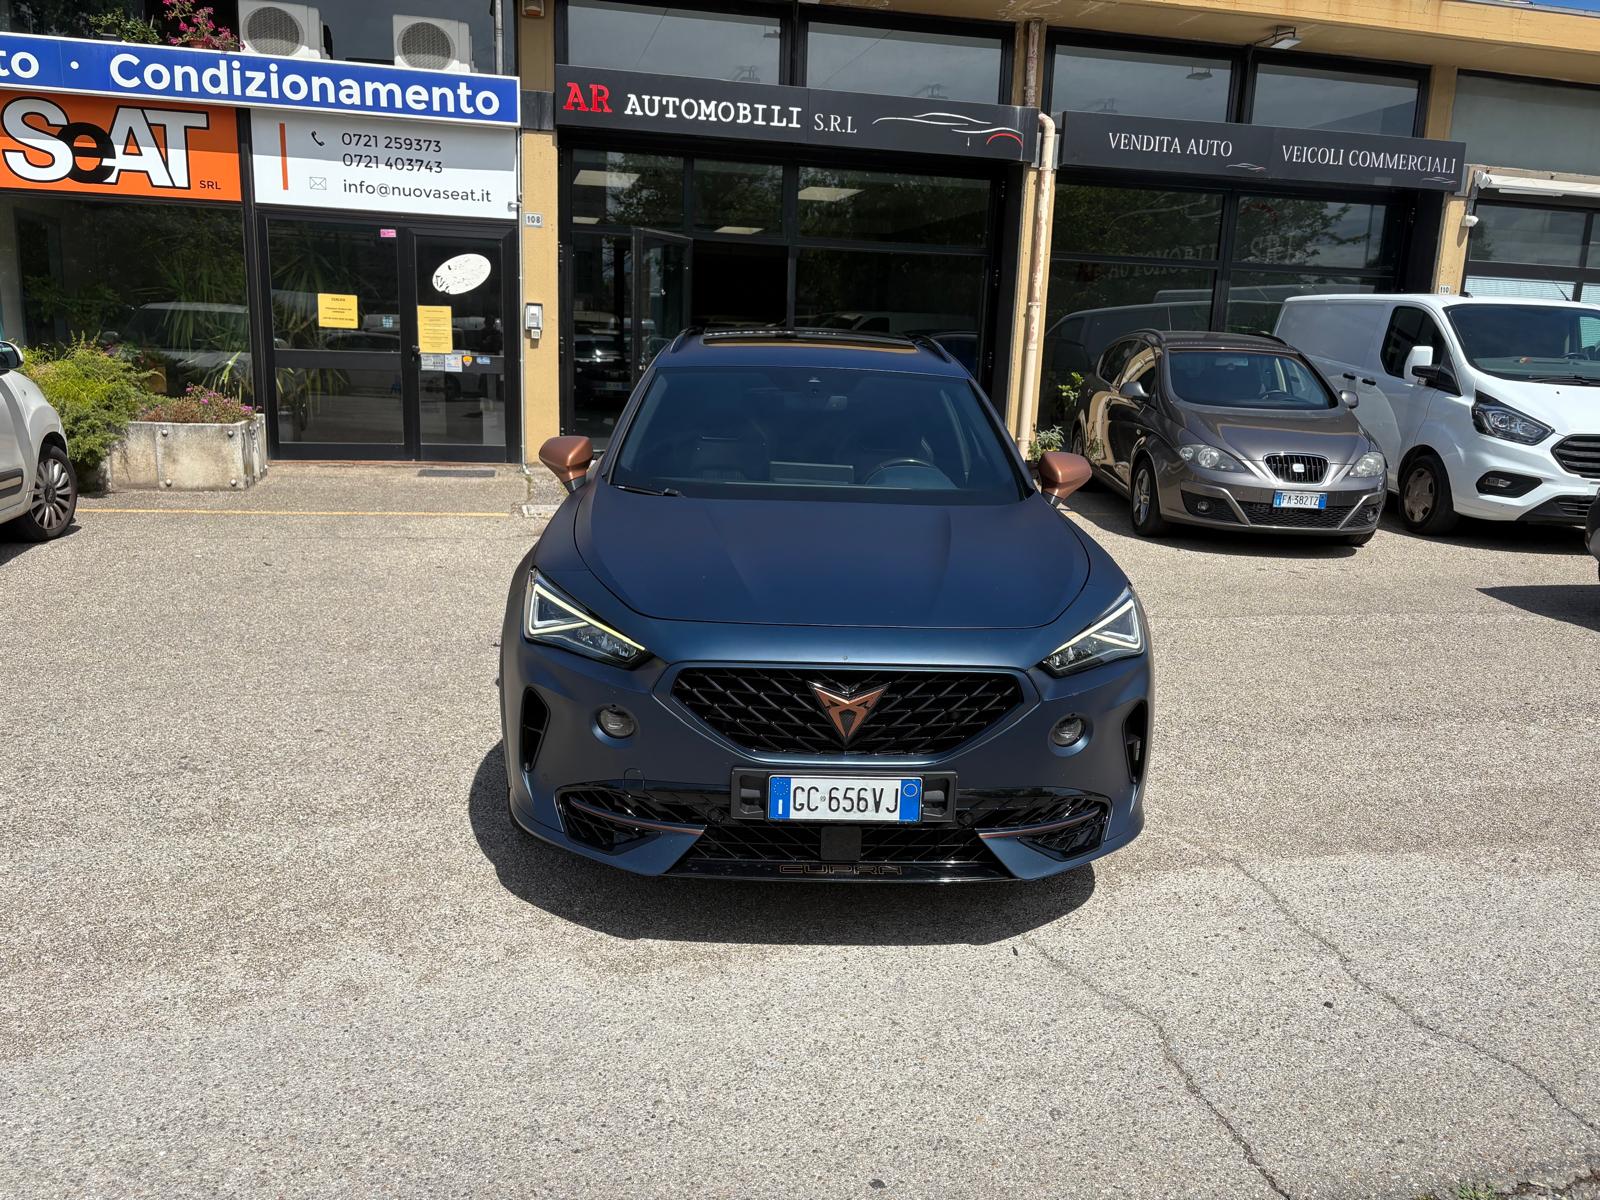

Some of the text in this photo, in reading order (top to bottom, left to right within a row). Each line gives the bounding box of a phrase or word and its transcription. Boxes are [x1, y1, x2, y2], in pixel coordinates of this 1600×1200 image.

[109, 53, 501, 116] Condizionamento
[562, 82, 857, 133] AR AUTOMOBILI S.R.L
[341, 132, 442, 153] 0721 259373
[1108, 132, 1233, 157] VENDITA AUTO
[342, 153, 443, 173] 0721 403743
[1282, 144, 1456, 174] VEICOLI COMMERCIALI
[199, 180, 221, 190] SRL
[343, 179, 492, 203] info@nuovaseat.it
[527, 215, 541, 224] 108
[792, 786, 819, 812] GC
[828, 786, 899, 814] 656VJ
[779, 864, 903, 875] CUPRA
